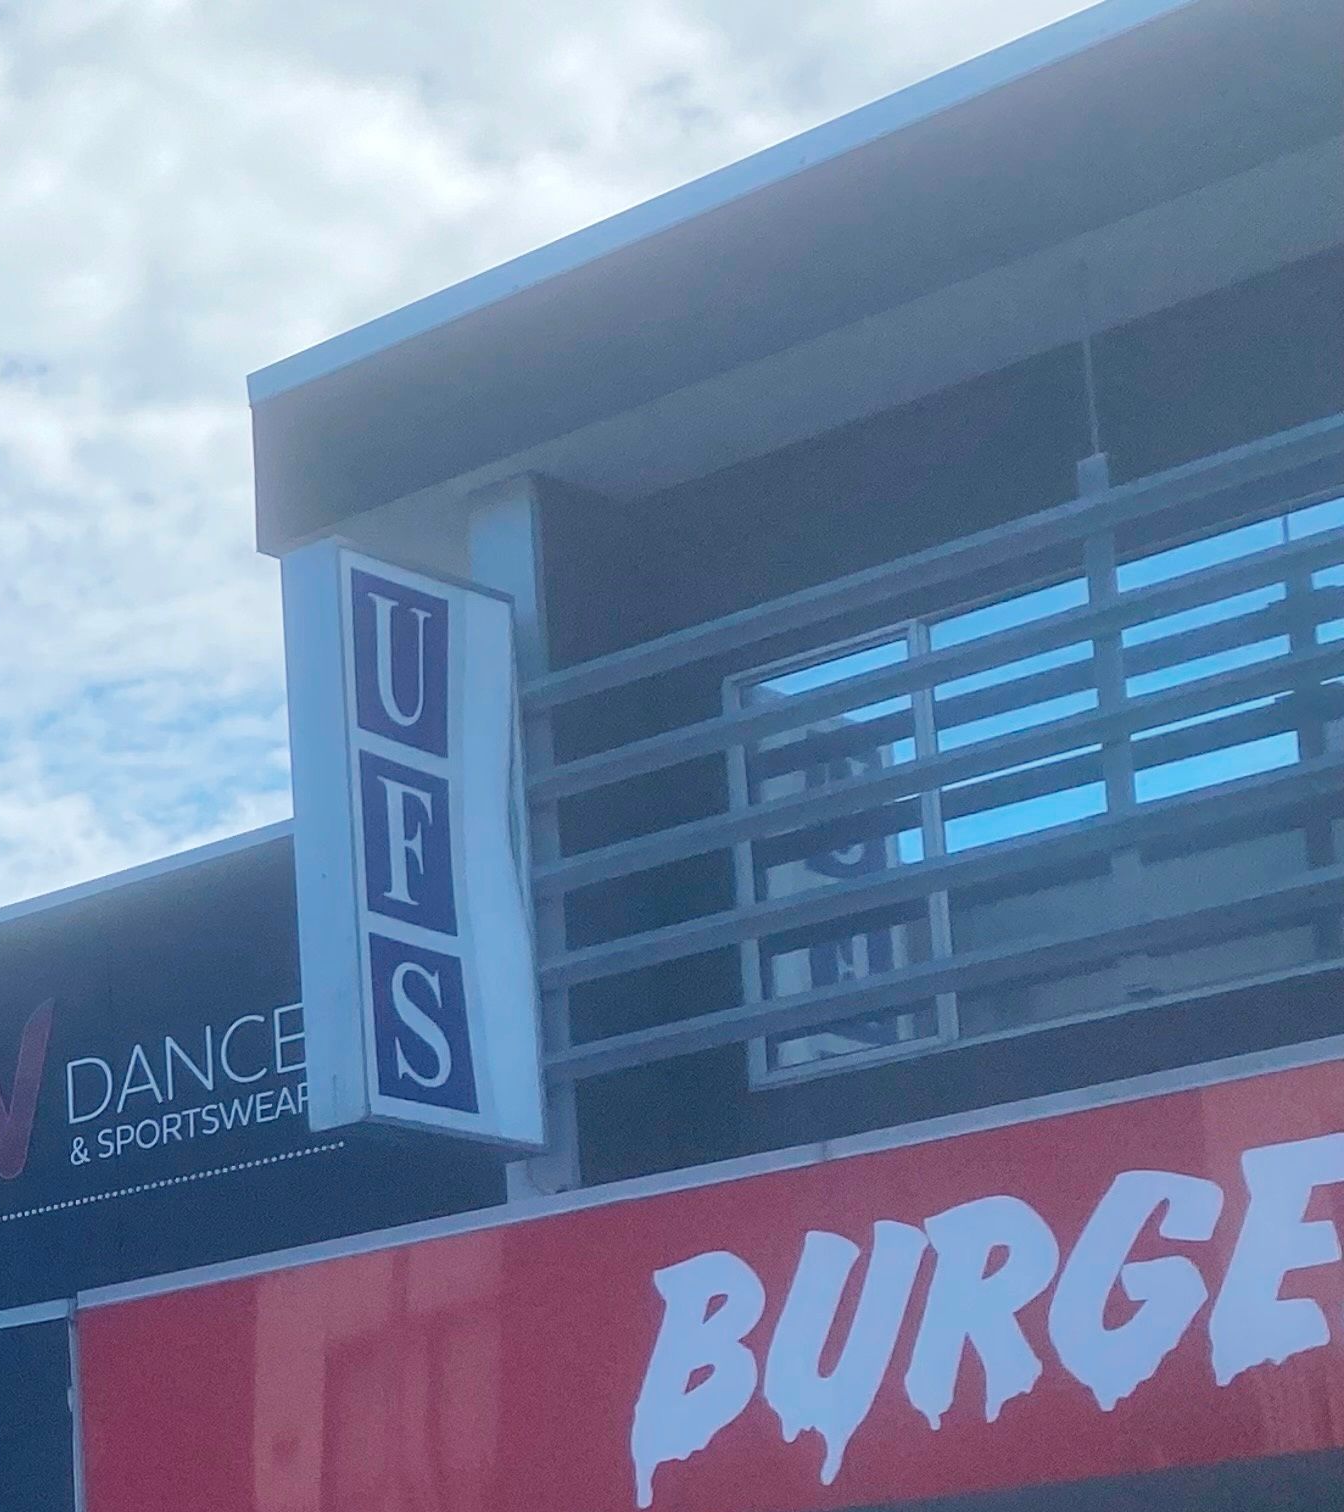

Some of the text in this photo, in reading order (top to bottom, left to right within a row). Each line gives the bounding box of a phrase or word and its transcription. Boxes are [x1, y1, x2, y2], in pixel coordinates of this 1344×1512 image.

[65, 1002, 310, 1125] DANCE
[70, 1136, 92, 1167] &
[630, 1131, 1344, 1510] BURGE
